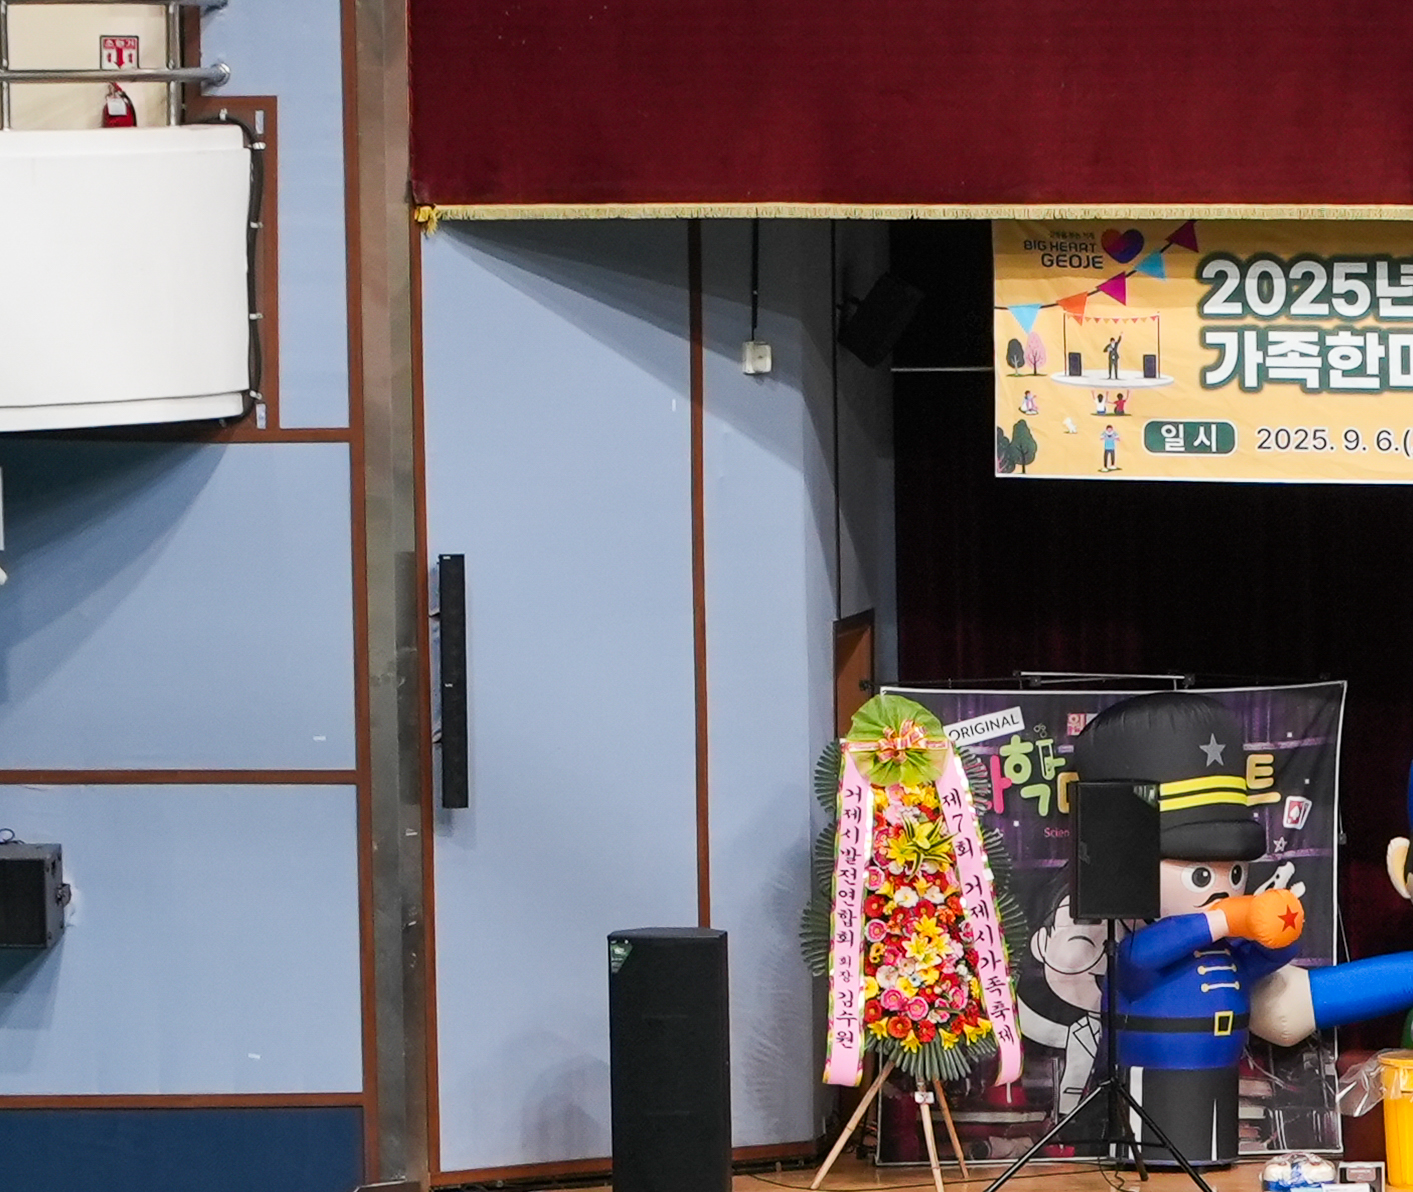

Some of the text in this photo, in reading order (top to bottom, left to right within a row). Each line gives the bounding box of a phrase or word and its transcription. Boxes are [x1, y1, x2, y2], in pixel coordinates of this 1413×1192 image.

[1024, 240, 1097, 253] BIG HEART
[1041, 254, 1104, 269] GEOJE
[1256, 428, 1334, 452] 2025.
[948, 713, 1020, 741] ORIGINAL
[942, 787, 974, 859] 제7회
[1044, 827, 1070, 838] Scien
[836, 784, 862, 1050] 거제시발전연합회 회장 김수원
